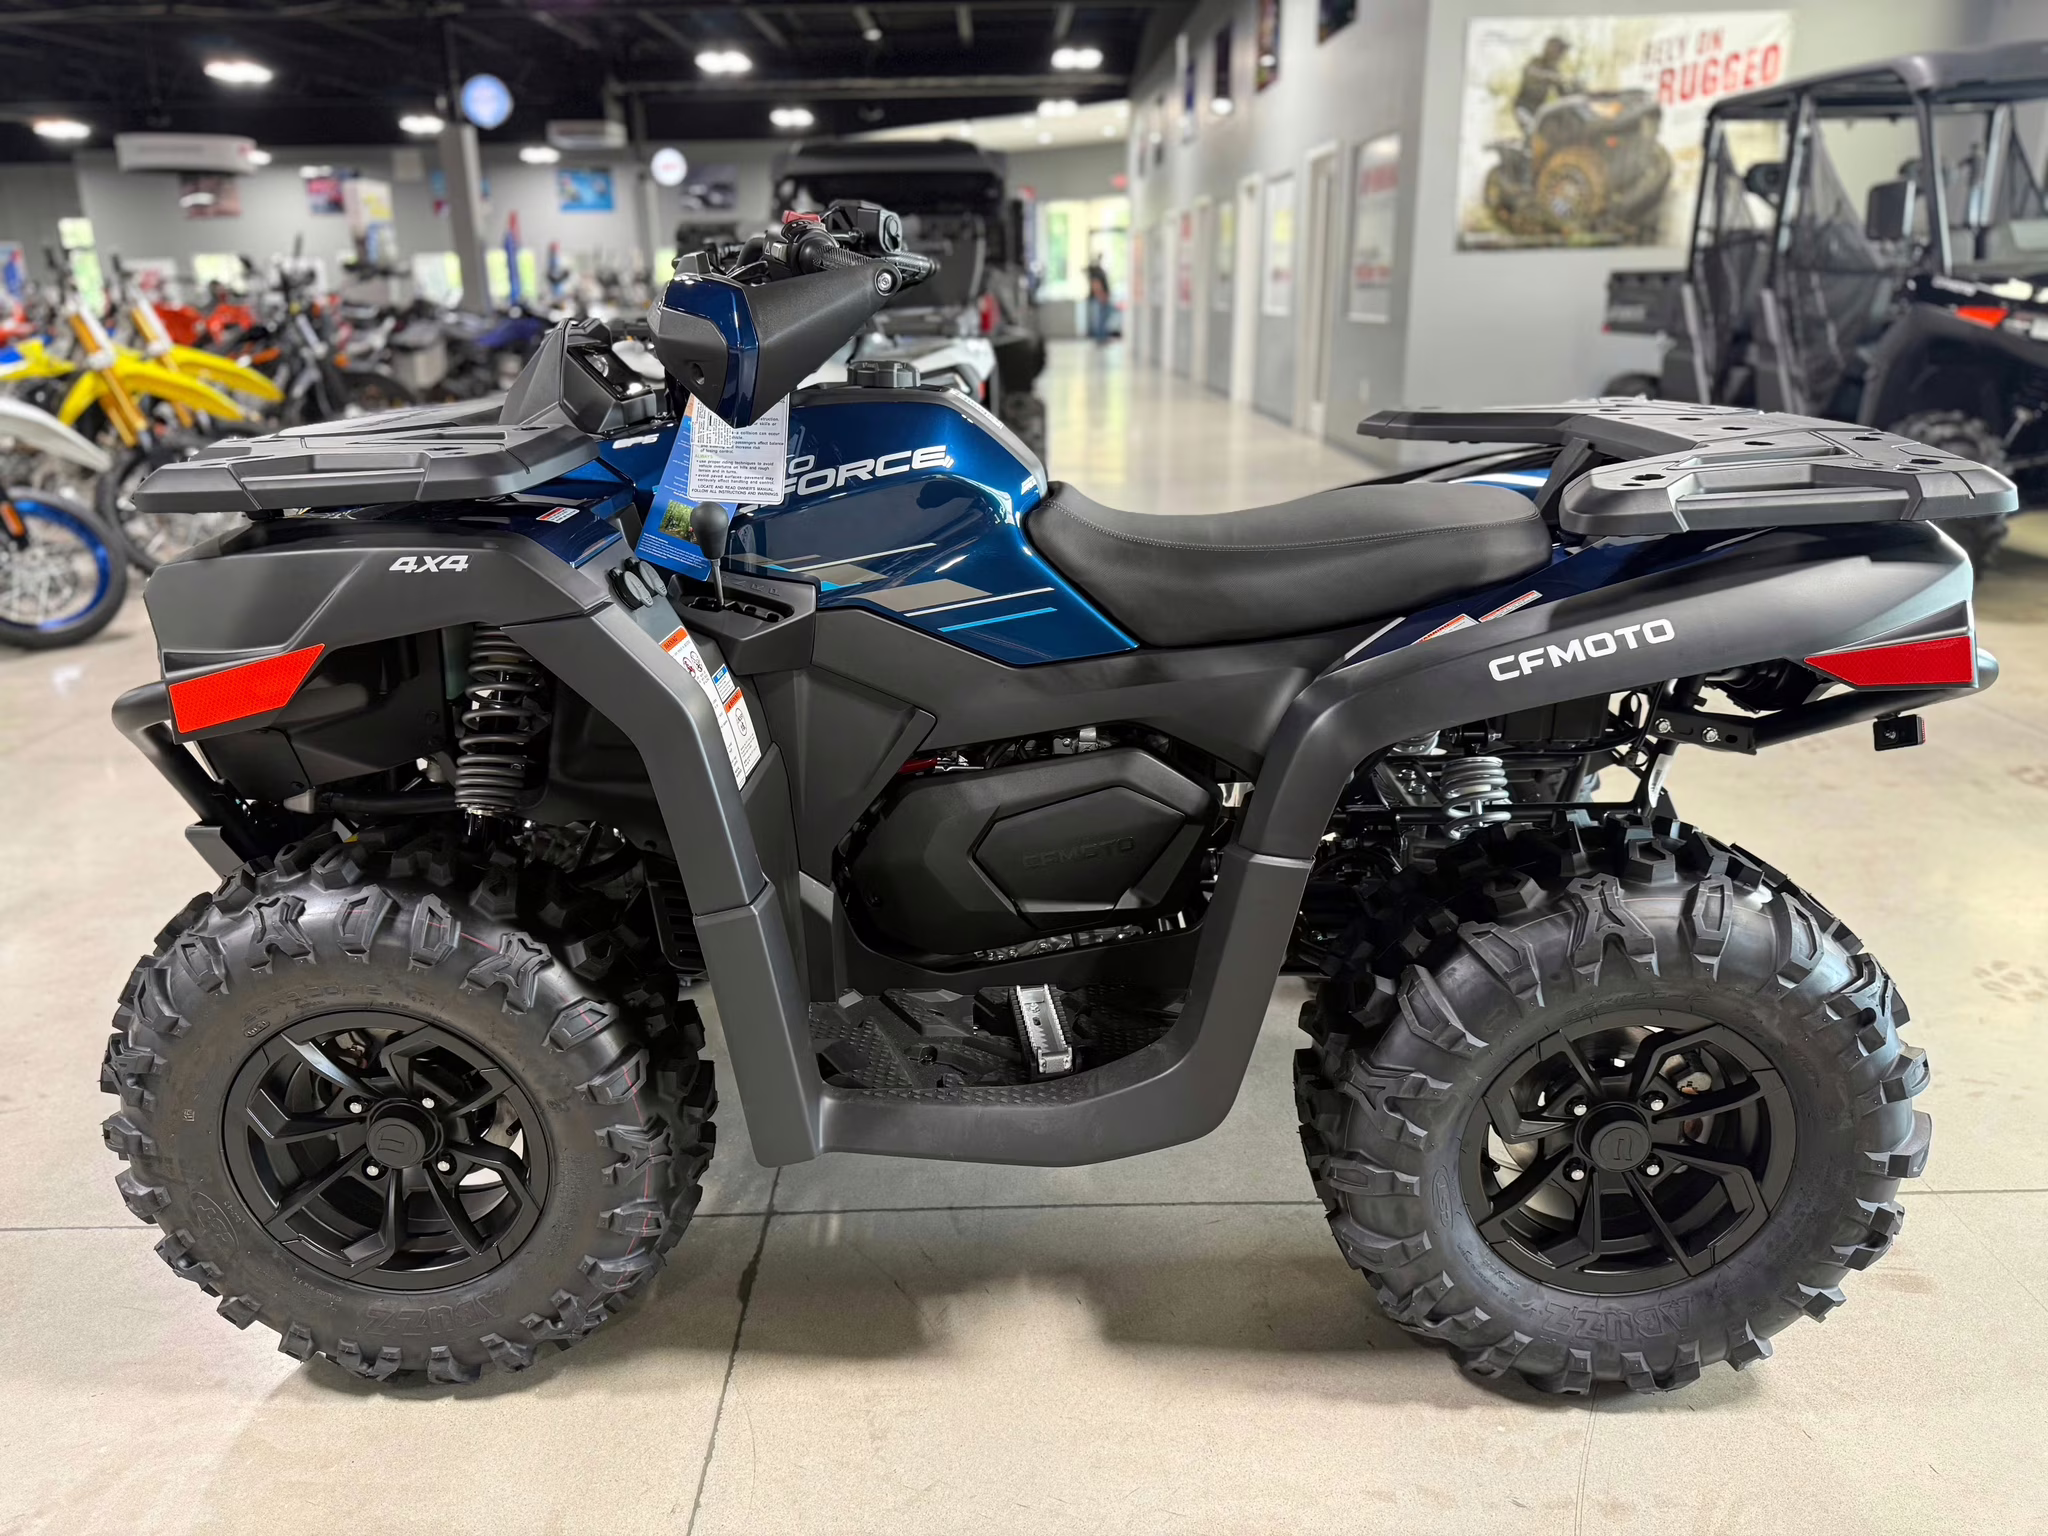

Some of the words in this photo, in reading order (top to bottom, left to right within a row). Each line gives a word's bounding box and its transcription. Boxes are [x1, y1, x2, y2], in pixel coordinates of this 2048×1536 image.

[1658, 43, 1780, 106] RUGGED
[1488, 618, 1676, 682] CFMOTO
[1541, 1297, 1694, 1342] ABUZZ
